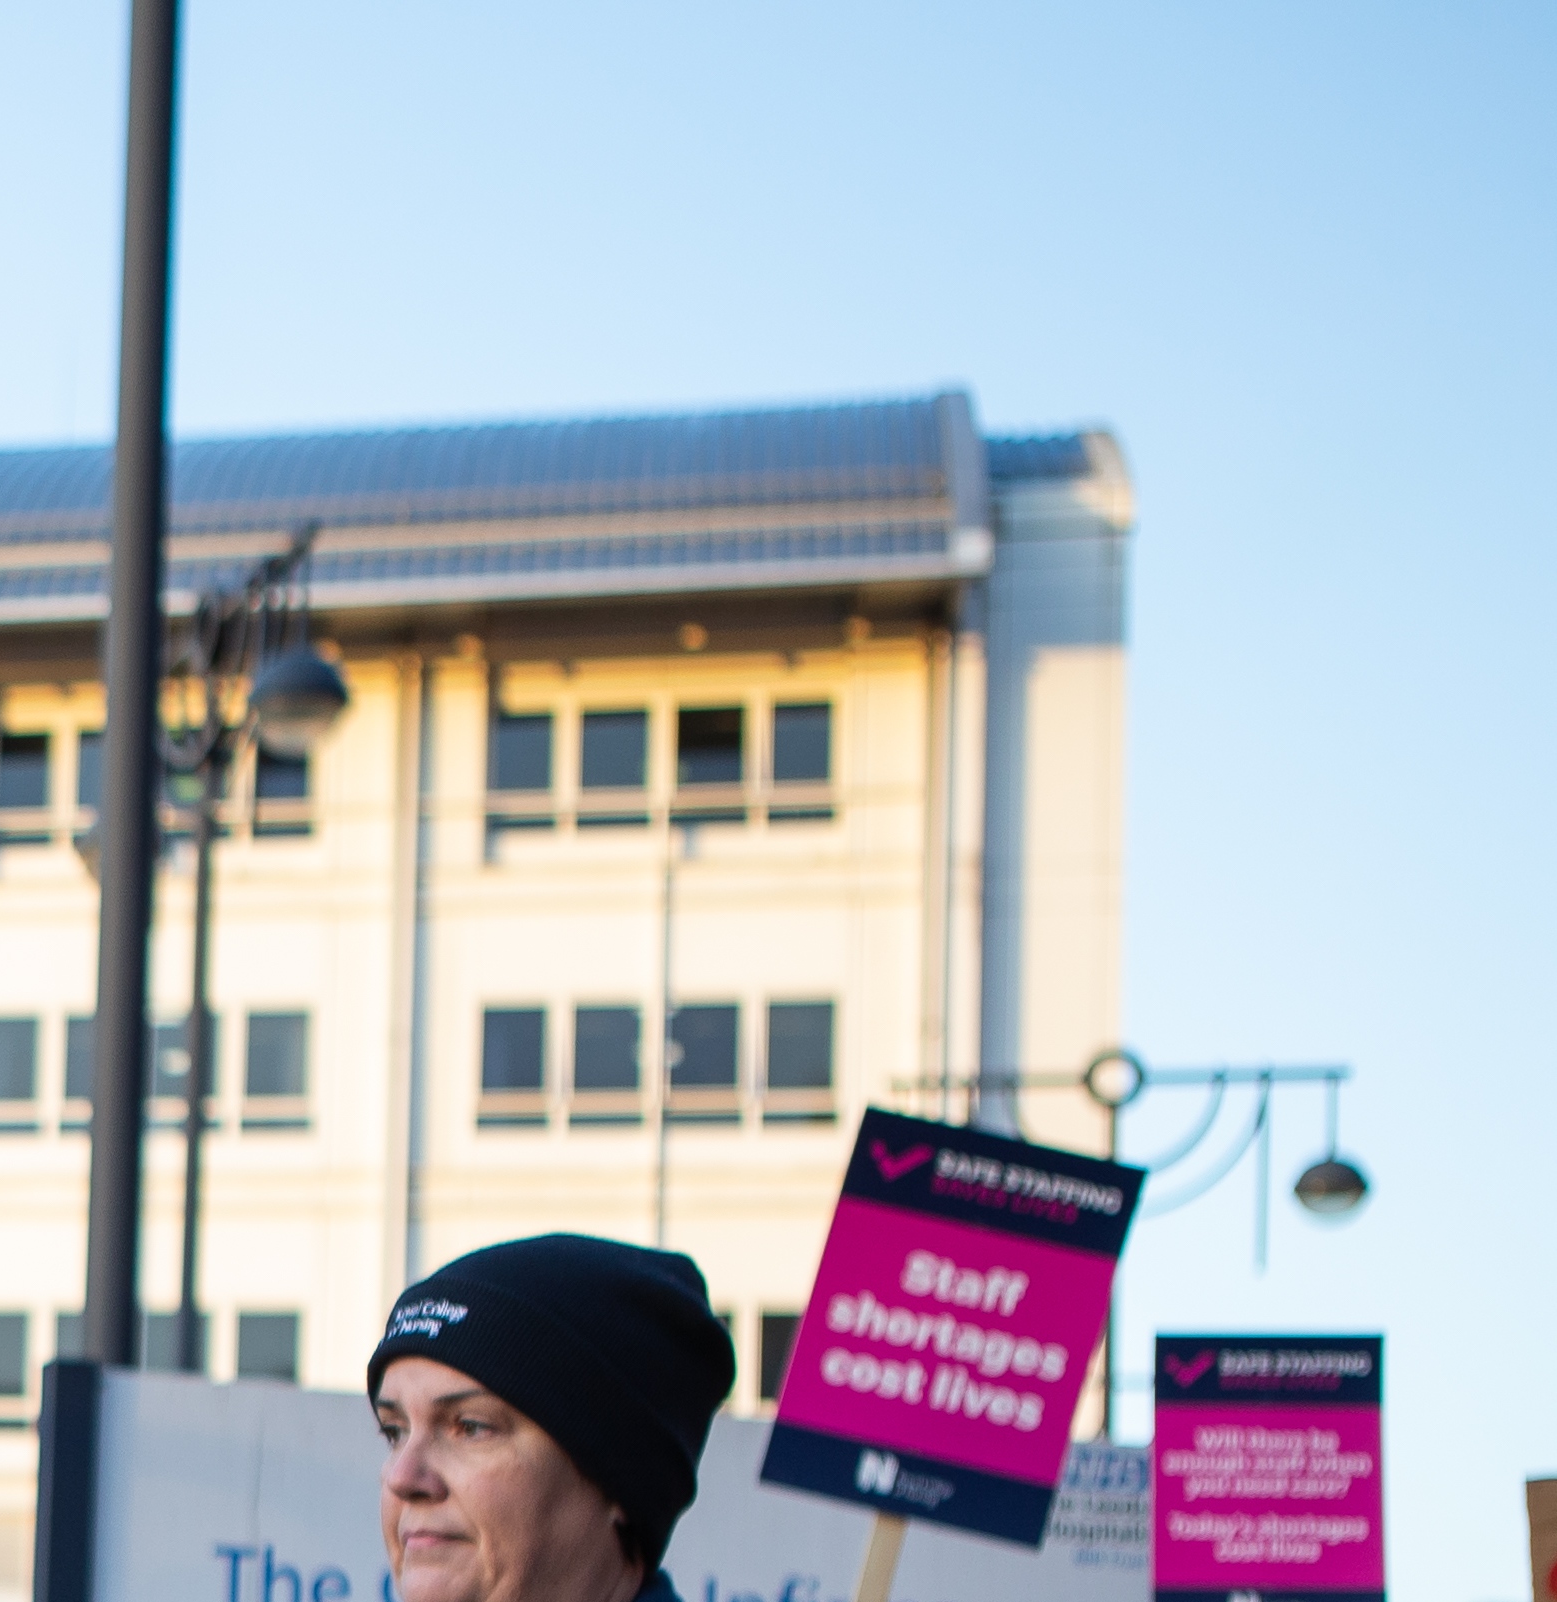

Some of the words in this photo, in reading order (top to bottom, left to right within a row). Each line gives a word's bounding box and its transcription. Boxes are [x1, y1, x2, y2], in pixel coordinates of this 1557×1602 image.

[936, 1148, 1004, 1190] SAFE
[1004, 1163, 1123, 1216] STAFFING
[899, 1249, 1030, 1318] Staff
[826, 1289, 1069, 1384] shortages
[820, 1347, 927, 1406] cost
[928, 1362, 1045, 1433] lives
